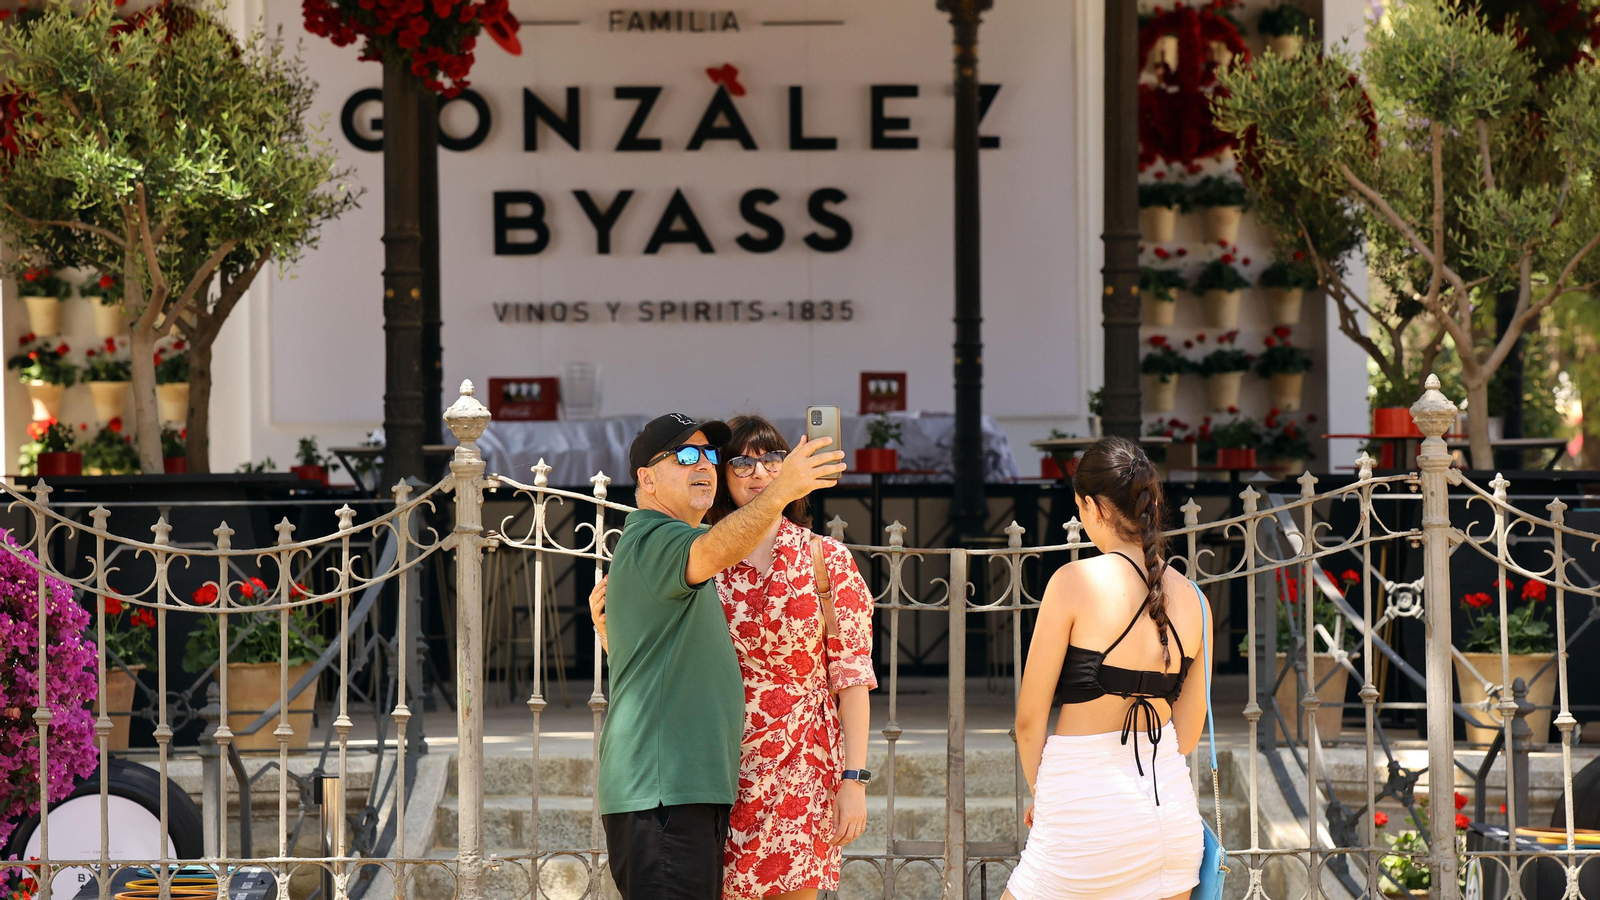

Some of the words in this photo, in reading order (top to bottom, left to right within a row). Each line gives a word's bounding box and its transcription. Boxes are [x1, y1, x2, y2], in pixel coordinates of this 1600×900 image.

[608, 10, 740, 33] FAMILIA
[493, 187, 853, 256] BYASS
[492, 302, 590, 323] VINOS
[606, 302, 621, 322] Y
